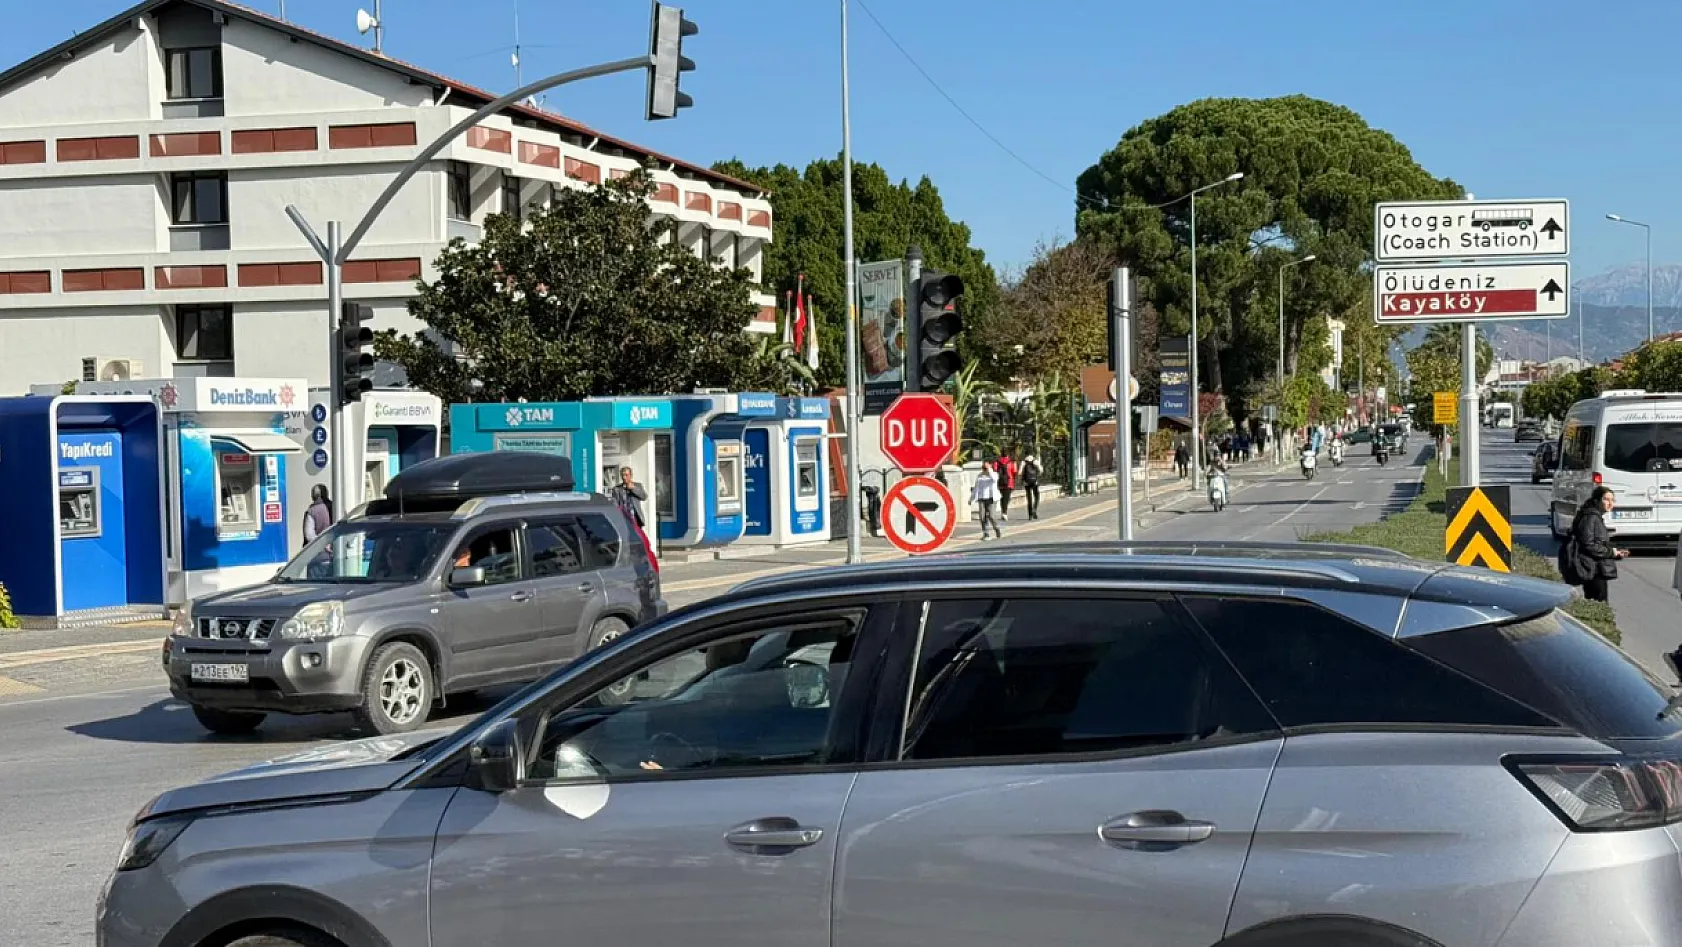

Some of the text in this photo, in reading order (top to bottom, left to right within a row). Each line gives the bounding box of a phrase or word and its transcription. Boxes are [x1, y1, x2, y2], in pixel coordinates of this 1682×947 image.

[1383, 213, 1465, 231] Otogar
[1383, 229, 1538, 254] (Coach Station)
[862, 267, 897, 282] SERVET
[1384, 272, 1495, 291] Ölüdeniz
[1384, 293, 1487, 316] Kayaköy
[210, 387, 277, 405] DenizBank
[523, 407, 553, 421] TAM
[640, 406, 659, 419] TAM
[887, 418, 949, 447] DUR
